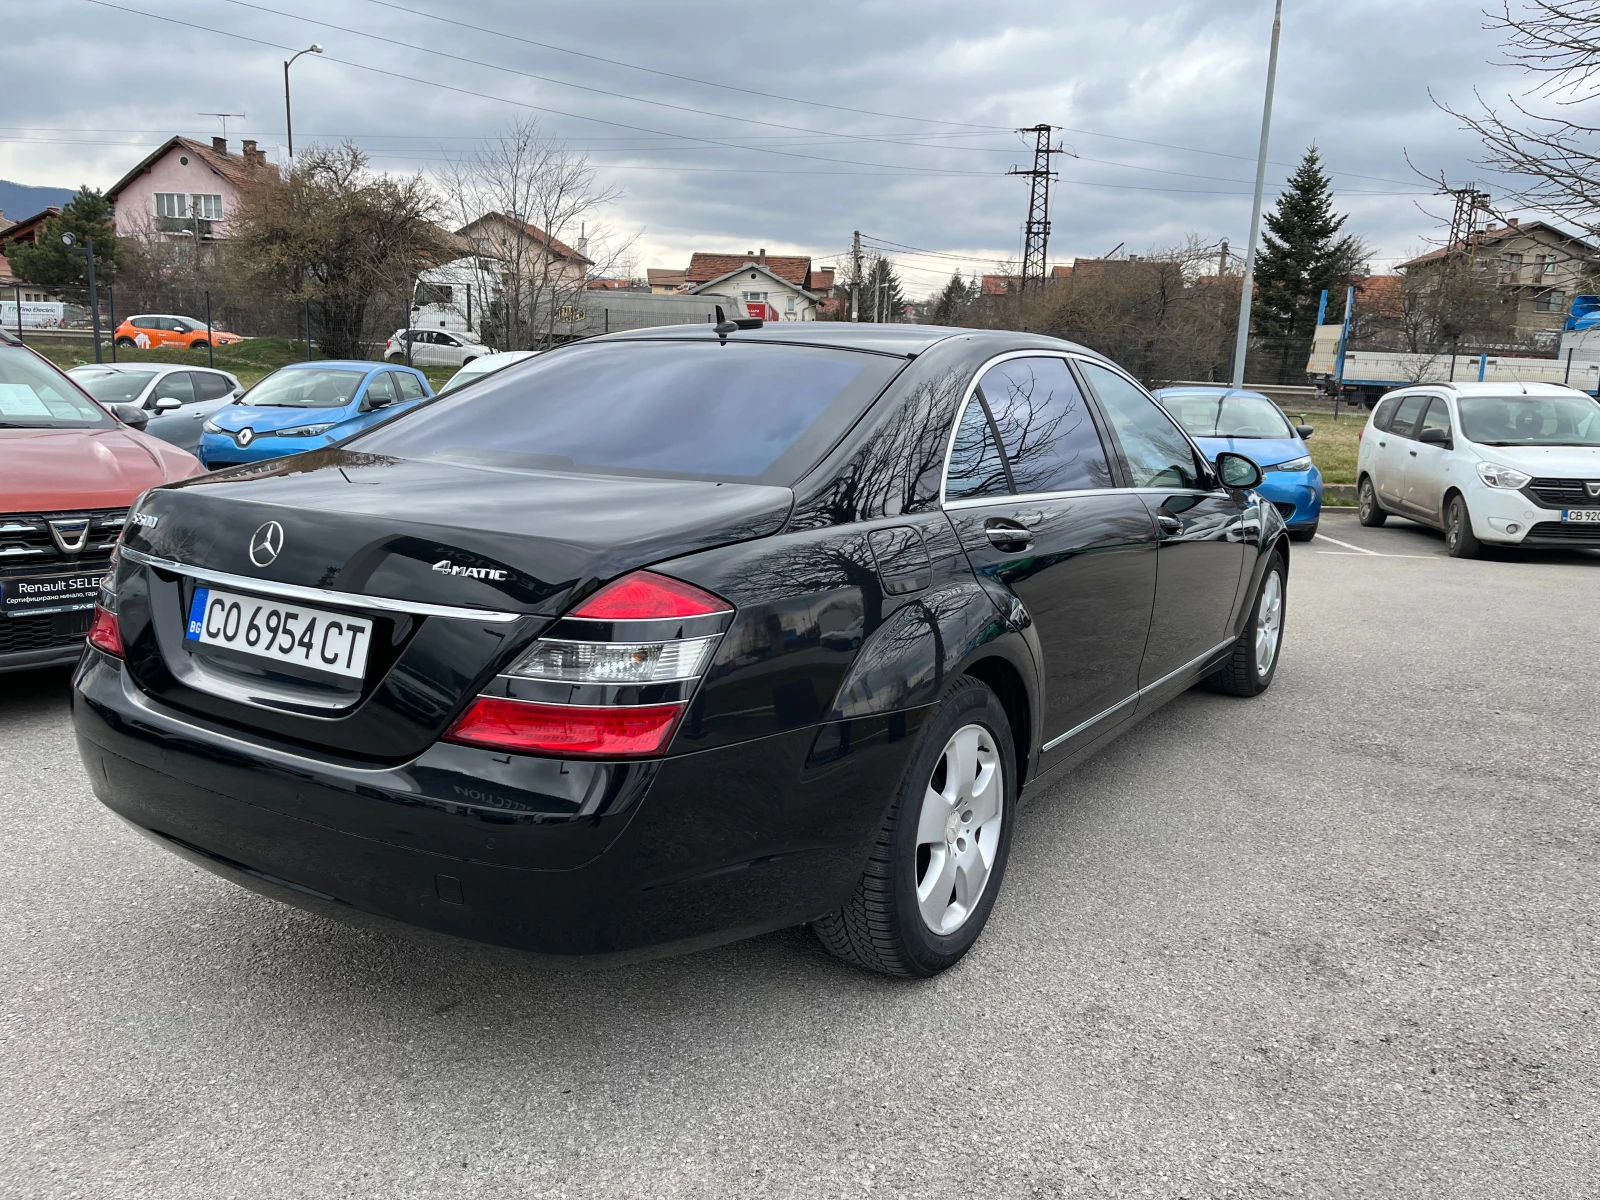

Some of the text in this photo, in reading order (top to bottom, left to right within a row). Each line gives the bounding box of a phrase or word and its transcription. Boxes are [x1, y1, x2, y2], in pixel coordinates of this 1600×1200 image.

[1570, 511, 1582, 520] CB
[432, 560, 508, 581] 4MATIC
[18, 580, 67, 593] Renault
[6, 594, 59, 604] Сертифицирано
[189, 621, 202, 634] BG
[205, 598, 366, 669] CO 6954 CT
